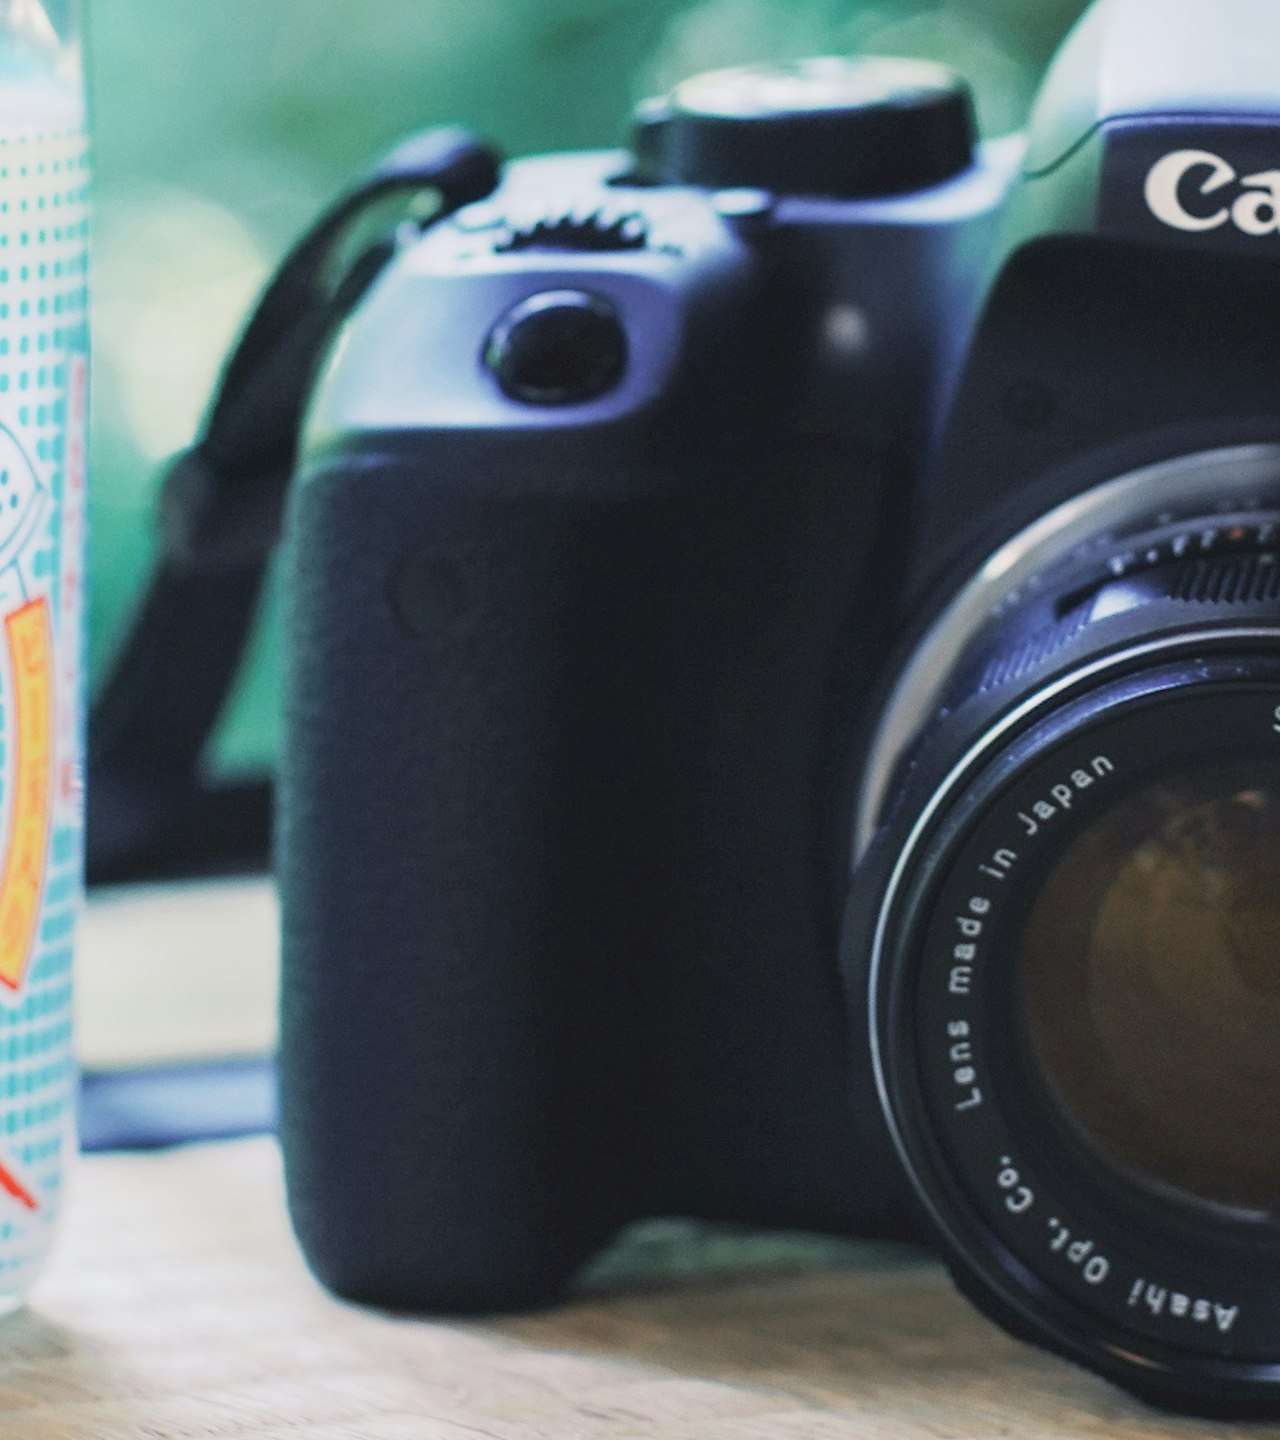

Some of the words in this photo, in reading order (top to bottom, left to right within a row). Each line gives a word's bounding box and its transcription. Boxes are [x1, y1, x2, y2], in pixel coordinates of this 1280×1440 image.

[1016, 749, 1116, 838] Japan
[978, 841, 1017, 880] in
[948, 892, 990, 995] made
[945, 1017, 984, 1114] Lens
[995, 1154, 1035, 1215] Co.
[1046, 1214, 1111, 1286] Opt.
[1128, 1276, 1239, 1332] Asahi
